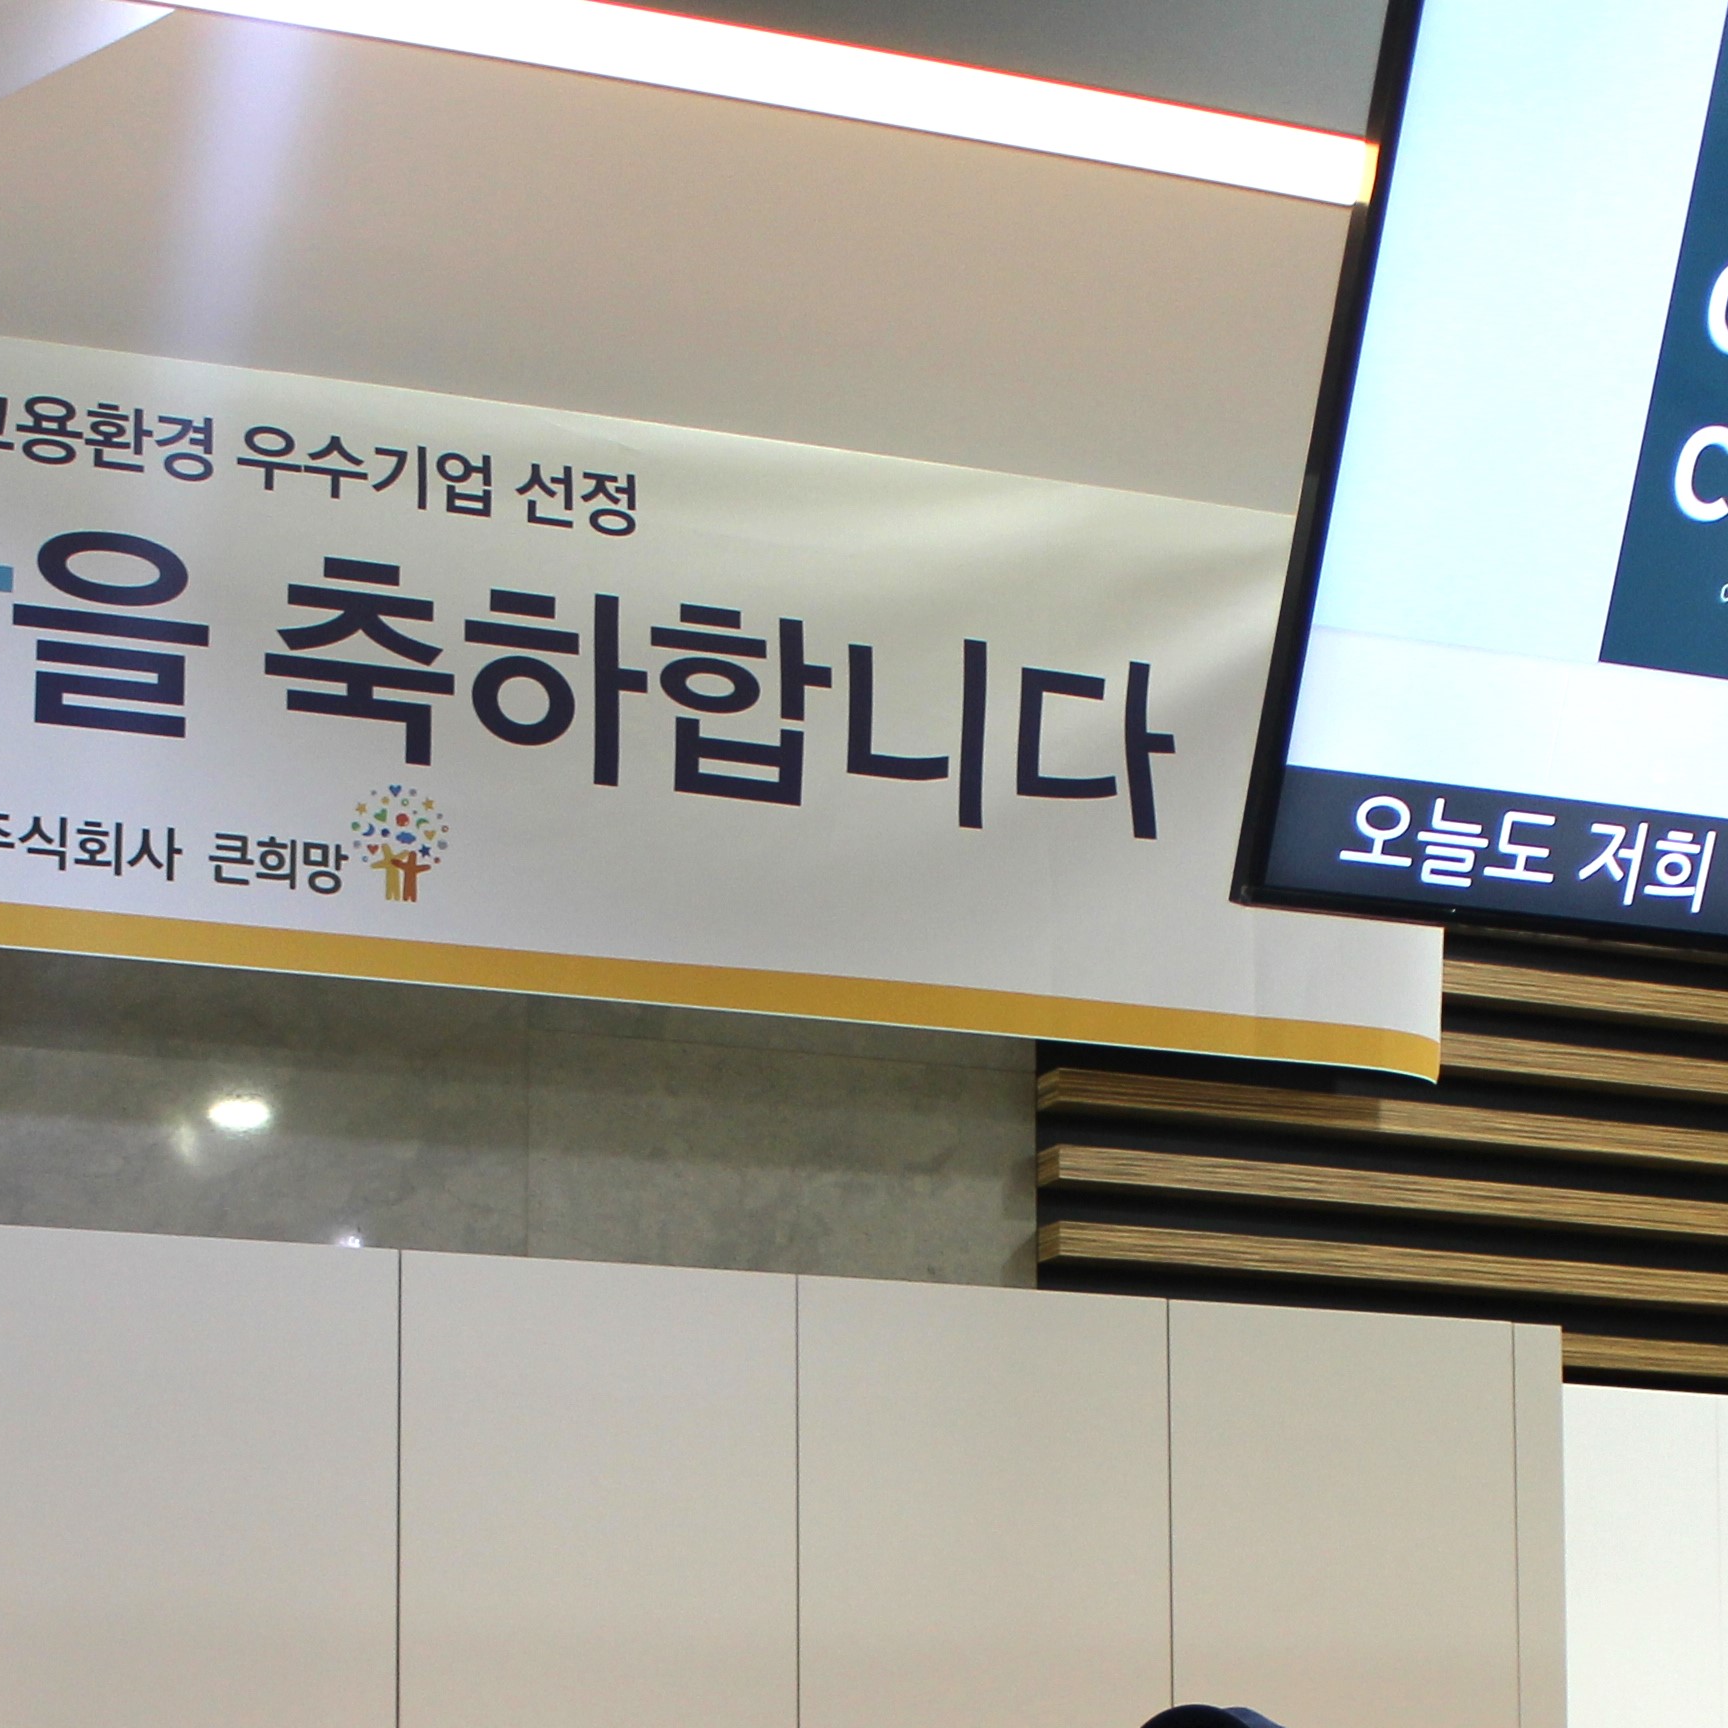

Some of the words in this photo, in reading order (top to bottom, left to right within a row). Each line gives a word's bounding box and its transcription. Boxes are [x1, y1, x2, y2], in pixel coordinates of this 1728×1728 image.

[236, 424, 492, 518] 우수기업
[515, 462, 638, 537] 선정
[262, 556, 1176, 840] 축하합니다
[207, 832, 350, 894] 큰희망
[1338, 795, 1557, 888] 오늘도
[1577, 822, 1713, 914] 저희
